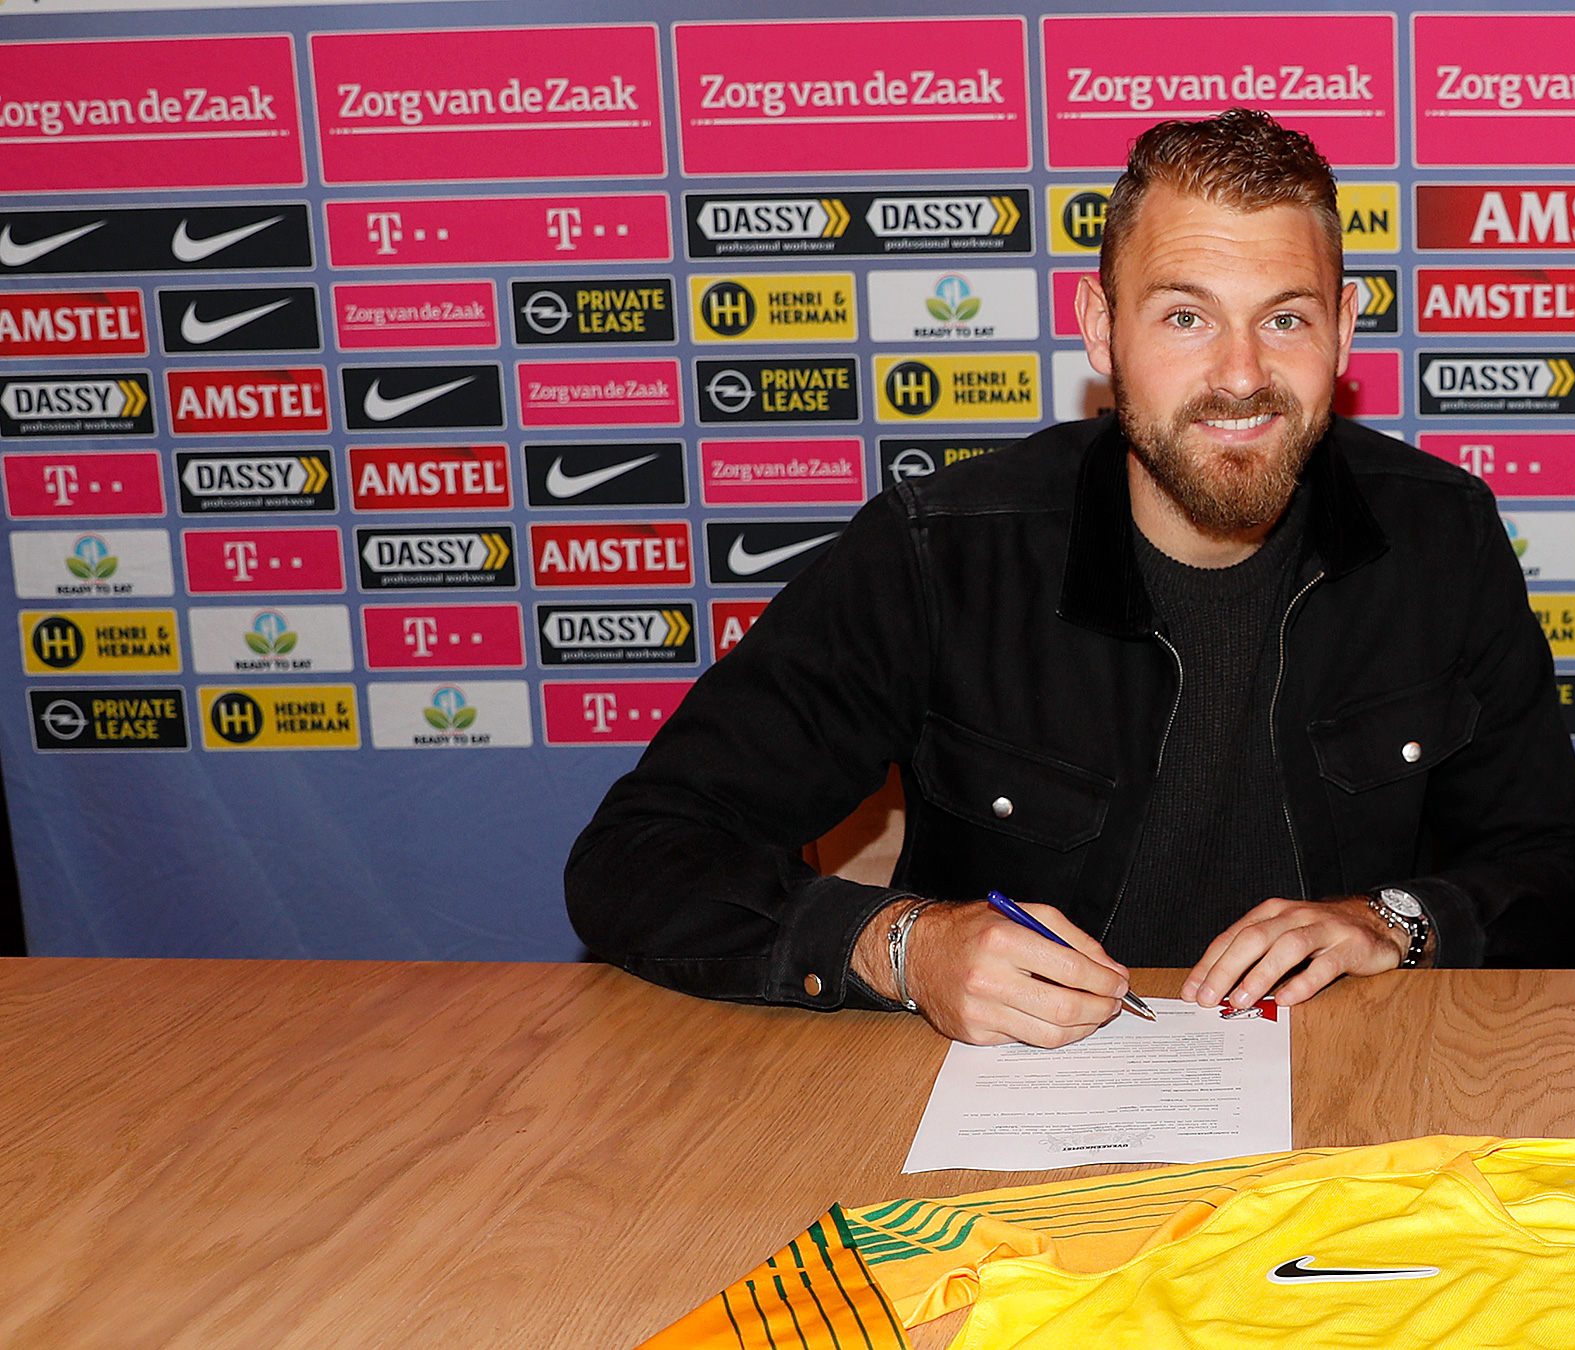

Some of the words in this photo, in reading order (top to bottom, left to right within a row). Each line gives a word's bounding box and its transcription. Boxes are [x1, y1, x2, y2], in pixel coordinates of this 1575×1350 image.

[699, 72, 787, 118] Zorg
[788, 80, 860, 107] van
[862, 70, 909, 106] de
[911, 68, 1005, 105] Zaak
[1067, 67, 1154, 111] Zorg
[1156, 75, 1227, 101] van
[1230, 65, 1277, 100] de
[1280, 64, 1374, 100] Zaak
[1436, 65, 1523, 109] Zorg
[0, 100, 64, 134] org
[66, 99, 136, 126] van
[138, 88, 182, 124] de
[184, 85, 276, 122] Zaak
[336, 81, 424, 127] Zorg
[424, 88, 496, 116] van
[497, 77, 544, 113] de
[545, 75, 639, 112] Zaak
[712, 203, 814, 234] DASSY
[881, 200, 984, 231] DASSY
[576, 288, 666, 311] PRIVATE
[768, 290, 822, 306] HENRI
[833, 290, 846, 305] &
[1422, 283, 1575, 318] AMSTEL
[0, 307, 139, 343] AMSTEL
[345, 304, 386, 326] Zorg
[387, 307, 420, 321] van
[419, 302, 443, 320] de
[441, 301, 486, 320] Zaak
[578, 311, 646, 333] LEASE
[769, 308, 847, 324] HERMAN
[760, 367, 850, 389] PRIVATE
[953, 370, 1006, 386] HENRI
[1018, 370, 1030, 385] &
[1438, 365, 1539, 391] DASSY
[15, 387, 111, 413] DASSY
[173, 383, 323, 420] AMSTEL
[528, 382, 570, 404] Zorg
[571, 385, 604, 399] van
[603, 381, 626, 398] de
[625, 380, 669, 398] Zaak
[762, 390, 830, 412] LEASE
[953, 388, 1031, 404] HERMAN
[196, 463, 294, 490] DASSY
[355, 460, 505, 496] AMSTEL
[712, 460, 752, 481] Zorg
[754, 463, 786, 477] van
[786, 459, 809, 476] de
[809, 458, 852, 476] Zaak
[376, 539, 475, 566] DASSY
[536, 537, 686, 573] AMSTEL
[95, 626, 147, 640] HENRI
[158, 627, 168, 640] &
[557, 616, 655, 642] DASSY
[98, 643, 171, 658] HERMAN
[91, 698, 177, 718] PRIVATE
[274, 701, 326, 715] HENRI
[336, 700, 348, 715] &
[94, 720, 160, 740] LEASE
[275, 718, 350, 733] HERMAN
